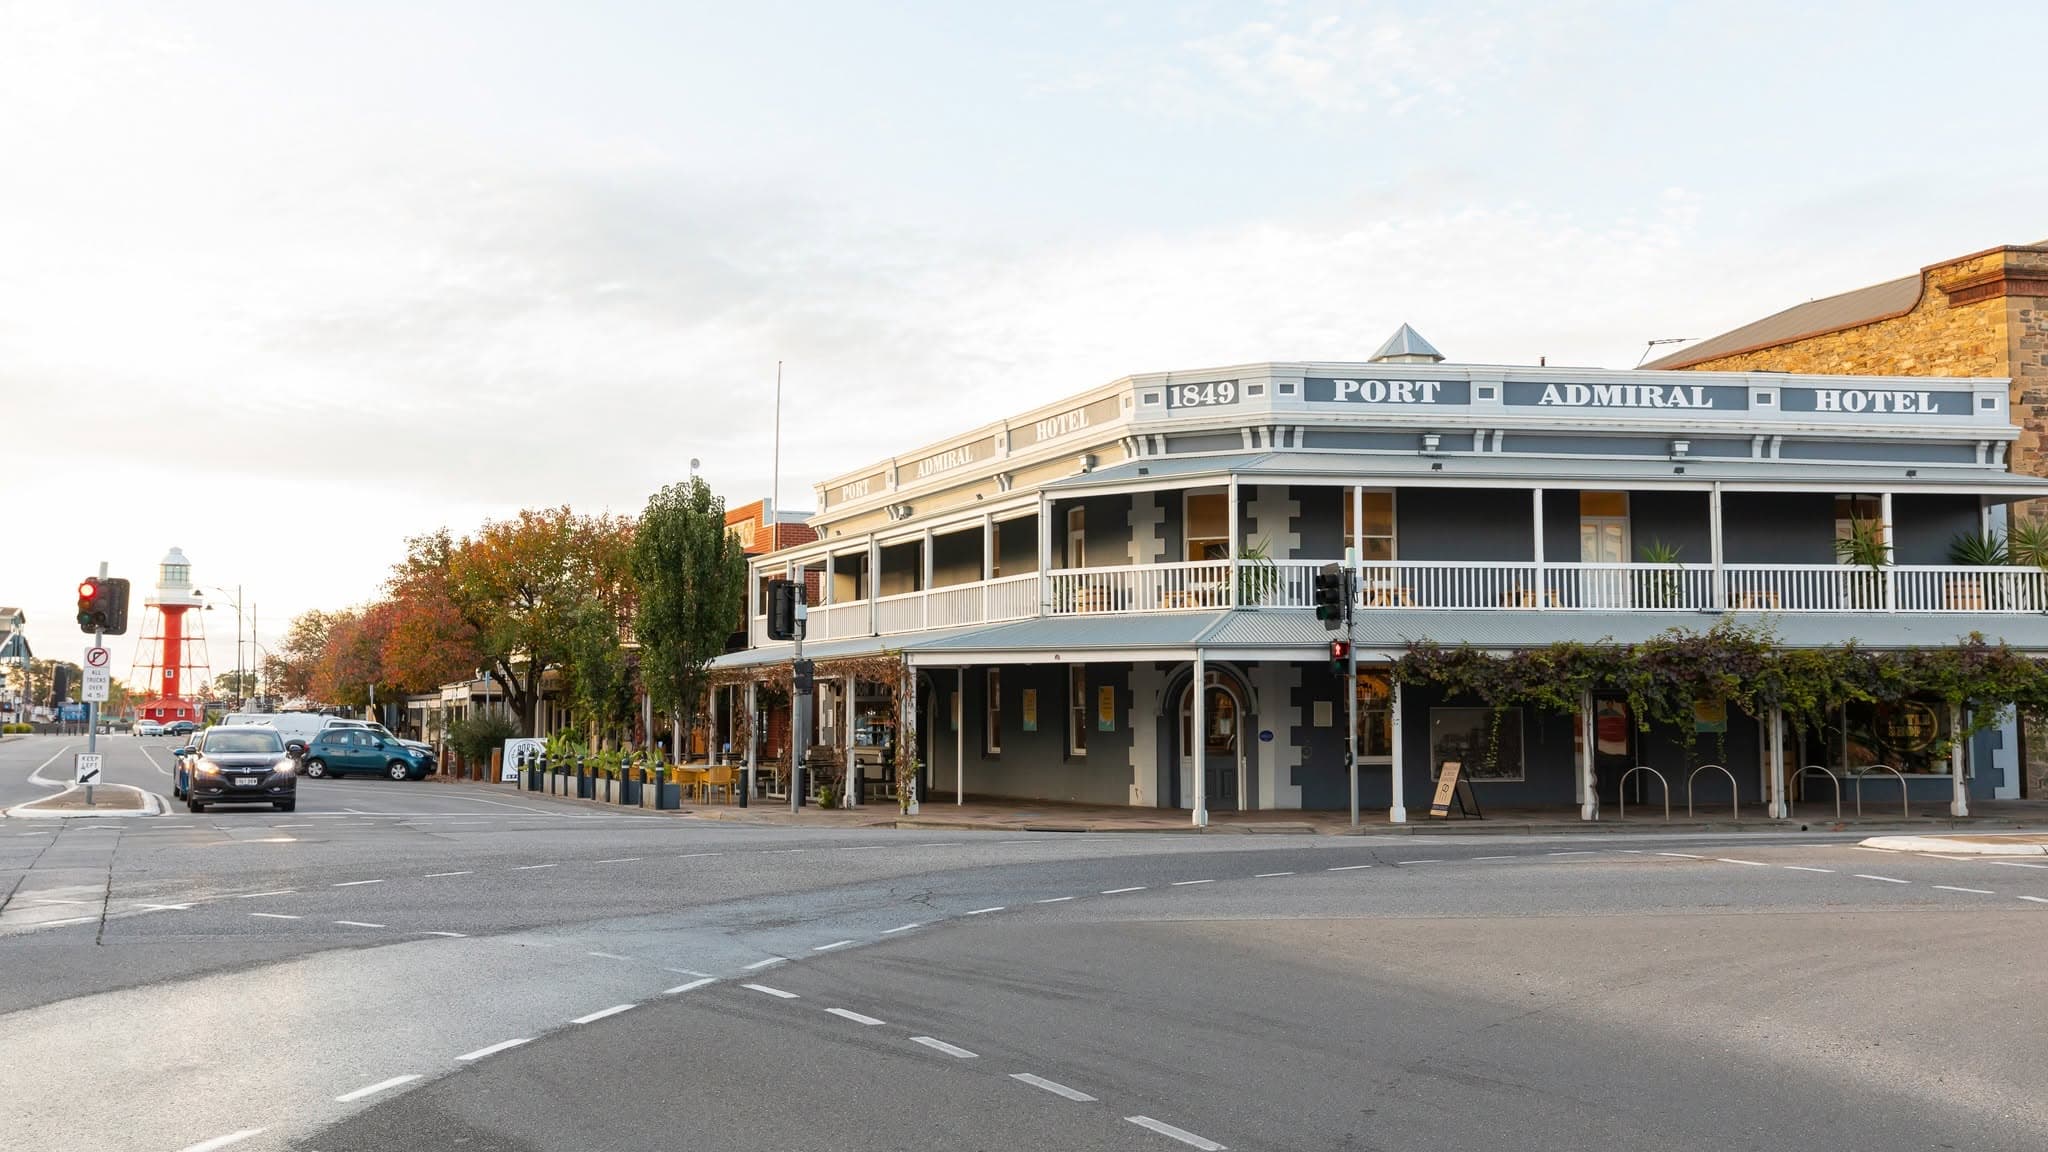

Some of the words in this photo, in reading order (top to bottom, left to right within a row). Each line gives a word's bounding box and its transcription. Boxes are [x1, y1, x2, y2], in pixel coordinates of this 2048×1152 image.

[1170, 382, 1235, 408] 1849
[1333, 379, 1440, 403] PORT
[1538, 384, 1713, 409] ADMIRAL
[1815, 390, 1938, 414] HOTEL
[842, 479, 870, 501] PORT
[917, 446, 974, 479] ADMIRAL
[1035, 408, 1089, 442] HOTEL
[81, 762, 98, 770] LEFT
